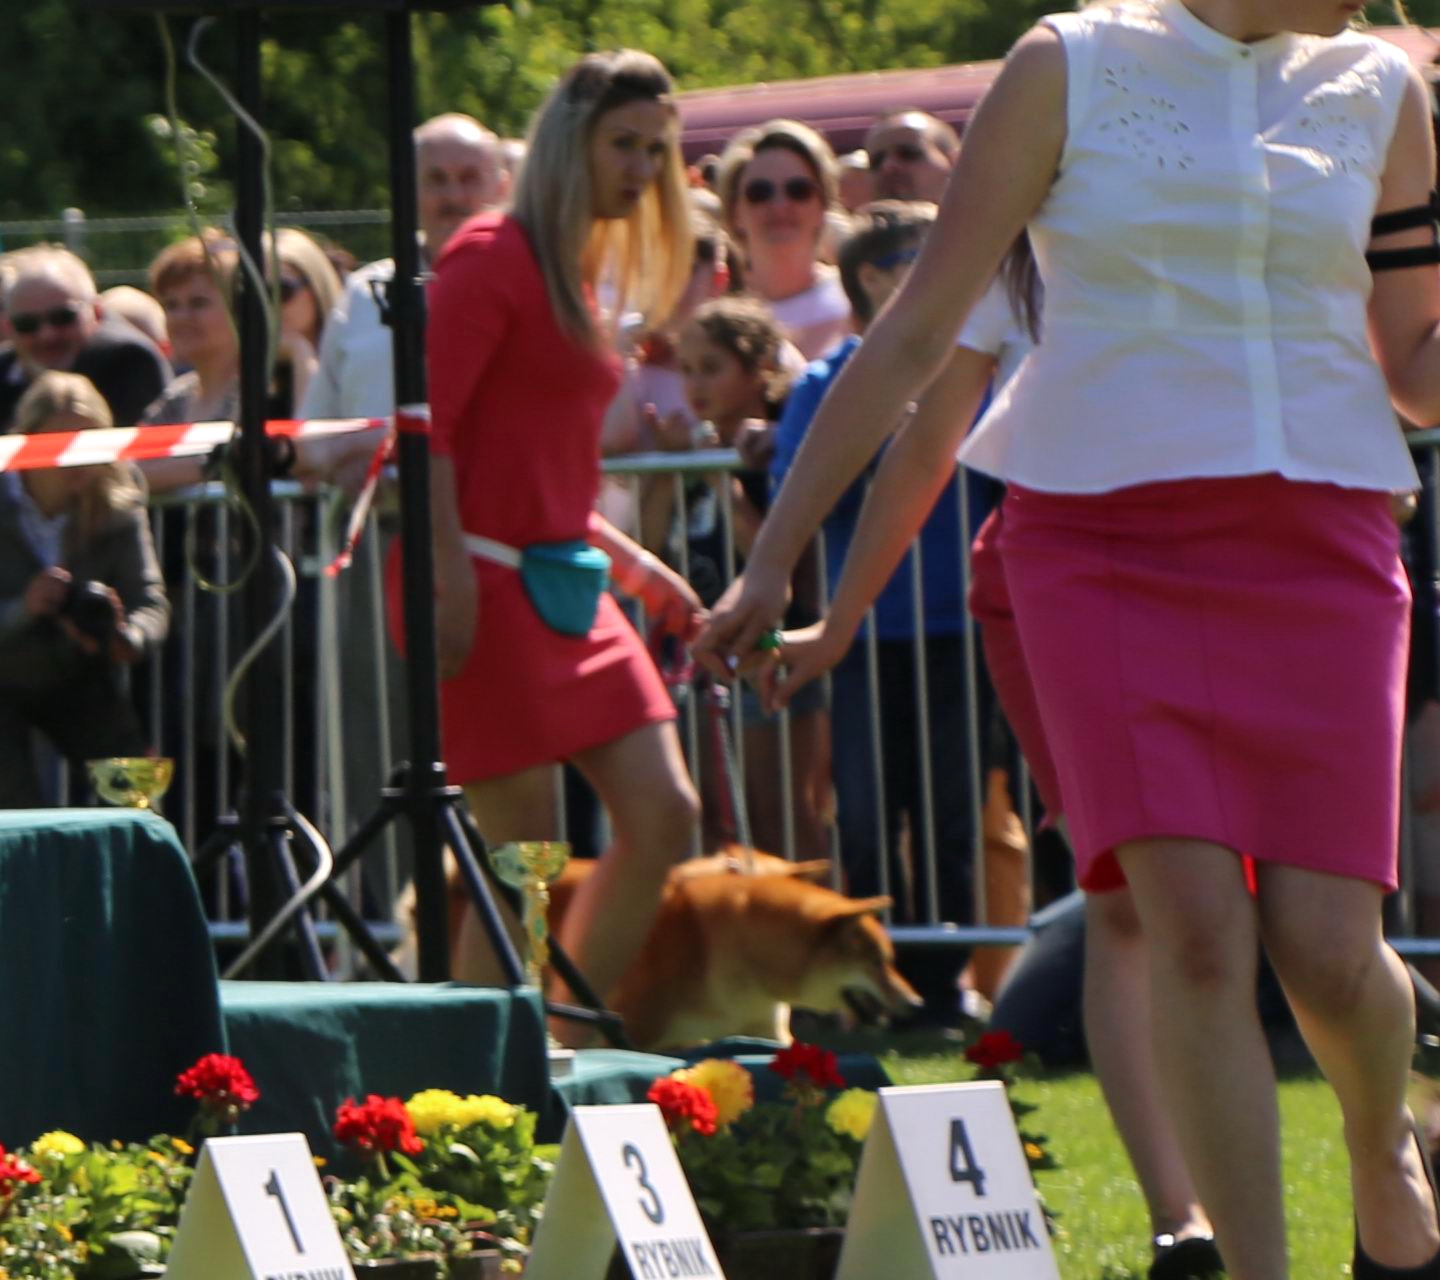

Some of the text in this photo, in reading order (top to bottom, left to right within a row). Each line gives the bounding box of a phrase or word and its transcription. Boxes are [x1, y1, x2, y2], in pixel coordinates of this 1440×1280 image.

[621, 1141, 665, 1227] 3
[948, 1117, 987, 1198] 4
[264, 1167, 306, 1256] 1
[929, 1207, 1042, 1258] RYBNIK
